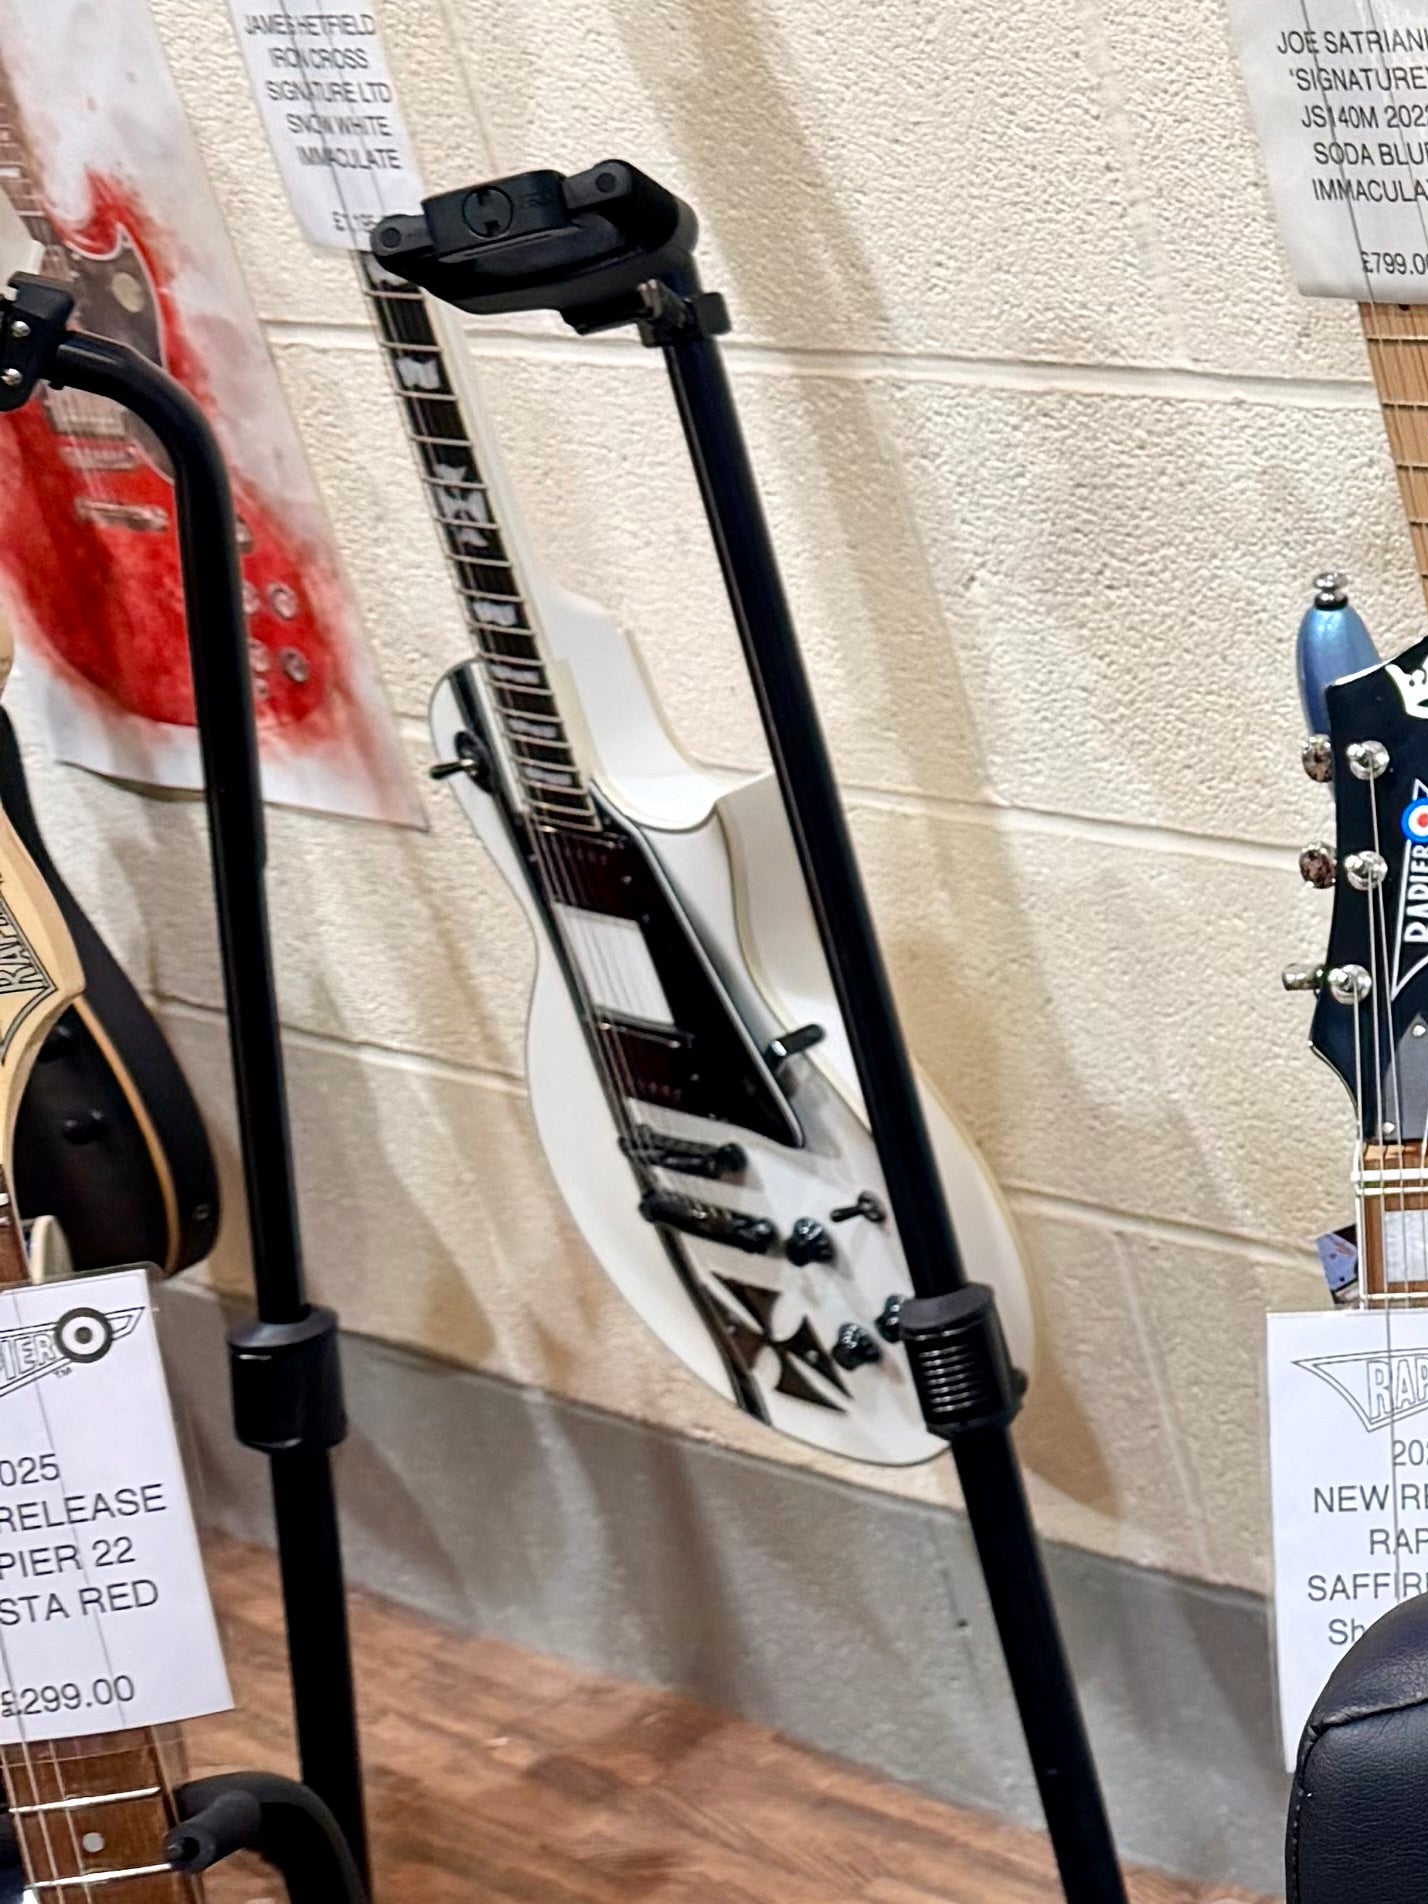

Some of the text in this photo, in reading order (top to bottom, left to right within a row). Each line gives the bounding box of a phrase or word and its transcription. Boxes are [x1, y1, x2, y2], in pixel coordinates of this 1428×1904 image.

[246, 13, 376, 36] JAMES HETFIELD
[1276, 30, 1320, 56] JOE
[269, 47, 369, 70] IRON CROSS
[266, 80, 393, 104] SIGNATURE LTD
[287, 113, 393, 137] SNOW WHITE
[1301, 105, 1380, 130] JS140M
[297, 146, 403, 170] IMMACULATE
[1313, 142, 1376, 167] SODA
[0, 1453, 61, 1487] 025
[0, 1483, 167, 1534] RELEASE
[1313, 1484, 1390, 1514] NEW
[0, 1536, 136, 1581] PIER 22
[0, 1579, 159, 1626] STA RED
[1, 1674, 135, 1718] £299.00
